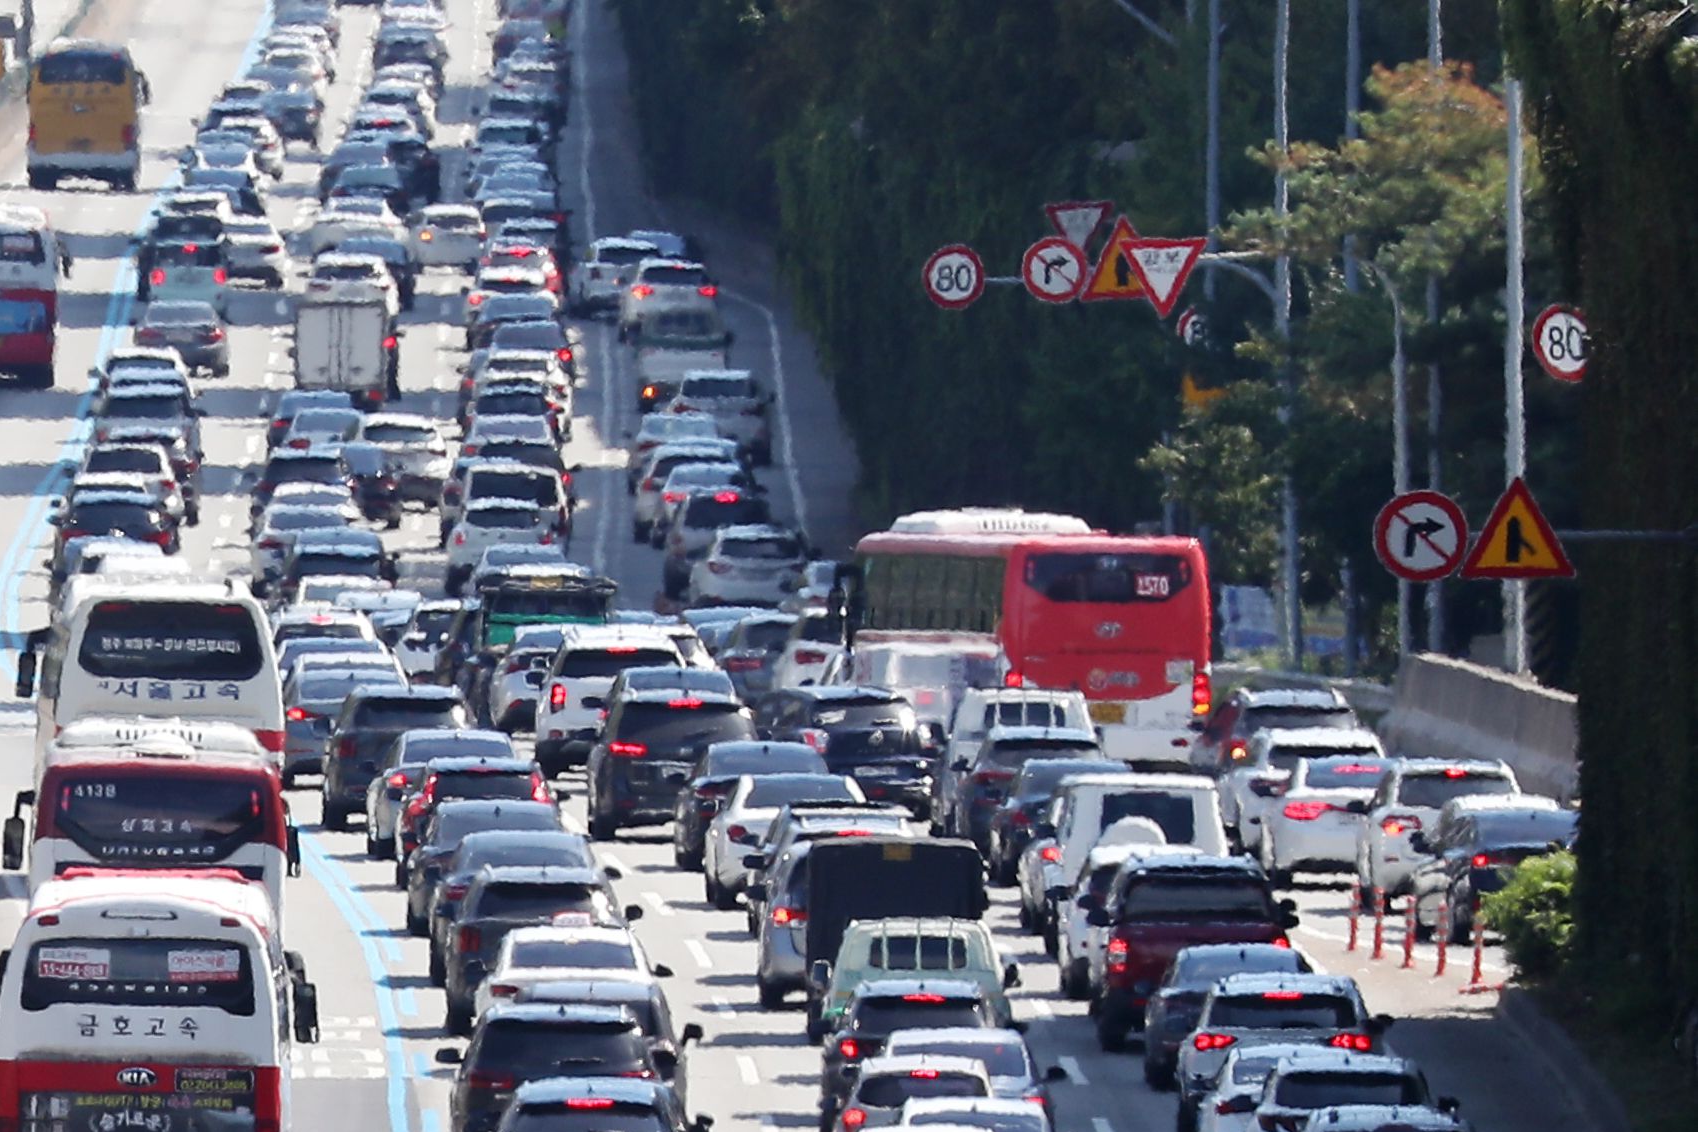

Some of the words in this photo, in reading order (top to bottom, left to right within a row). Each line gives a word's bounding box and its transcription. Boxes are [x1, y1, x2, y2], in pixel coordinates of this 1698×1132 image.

[936, 263, 972, 292] 80
[1549, 325, 1586, 362] 80
[77, 1014, 200, 1041] 금호고속
[122, 1072, 150, 1086] KIA
